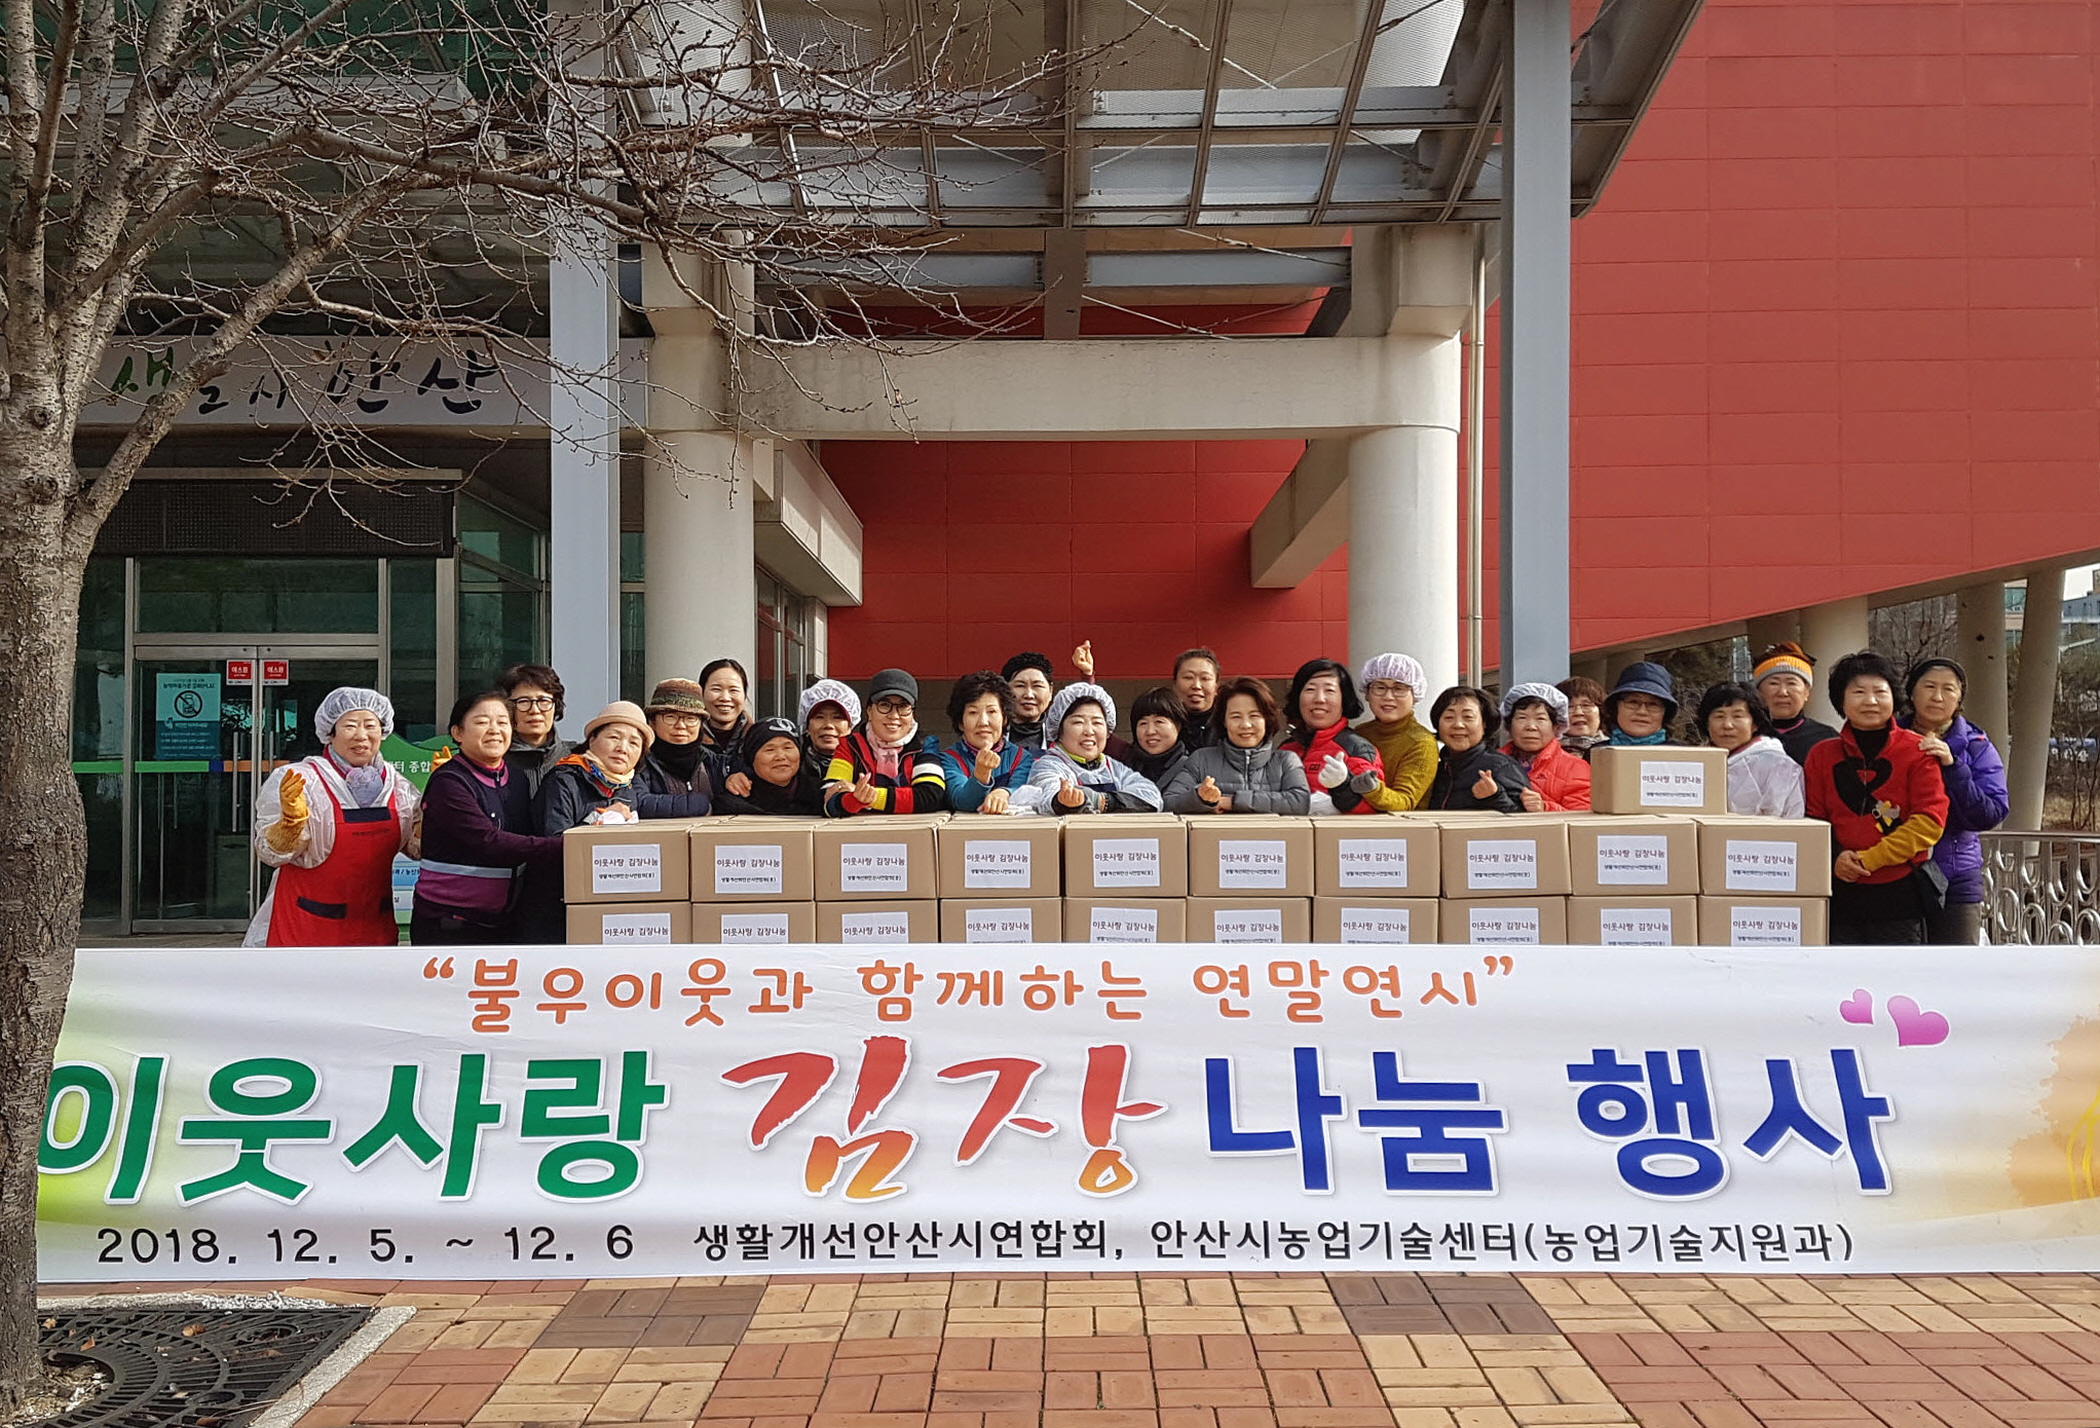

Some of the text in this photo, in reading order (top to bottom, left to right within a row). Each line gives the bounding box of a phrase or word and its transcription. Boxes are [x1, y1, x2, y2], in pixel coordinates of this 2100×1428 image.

[409, 760, 431, 773] 종합
[1642, 774, 1701, 784] 이웃사랑 김장나눔
[966, 852, 1028, 863] 이웃사랑 김장나눔
[1094, 851, 1157, 862] 이웃사랑 김장나눔
[1220, 852, 1283, 863] 이웃사랑 김장나눔
[1340, 852, 1404, 862] 이웃사랑 김장나눔
[1469, 852, 1534, 863] 이웃사랑 김장나눔
[1599, 848, 1665, 859] 이웃사랑 김장나눔
[1727, 853, 1795, 865] 이웃사랑 김장나눔
[593, 857, 658, 868] 이웃사랑 김장나눔
[716, 857, 780, 868] 이웃사랑 김장나눔
[842, 856, 905, 866] 이웃사랑 김장나눔
[843, 924, 906, 936] 이웃사랑 김장나눔
[967, 920, 1030, 932] 이웃사랑 김장나눔
[1092, 920, 1155, 932] 이웃사랑 김장나눔
[1216, 922, 1280, 933] 이웃사랑 김장나눔
[1342, 920, 1407, 932] 이웃사랑 김장나눔
[1471, 920, 1536, 931] 이웃사랑 김장나눔
[1602, 921, 1669, 932] 이웃사랑 김장나눔
[1732, 919, 1798, 931] 이웃사랑 김장나눔
[604, 925, 669, 937] 이웃사랑 김장나눔
[722, 926, 787, 937] 이웃사랑 김장나눔
[857, 959, 1147, 1022] 함께하는
[38, 1034, 1894, 1203] 이웃사랑 김장 나눔 행사
[97, 1227, 237, 1264] 2018.
[266, 1228, 338, 1264] 12.
[369, 1228, 414, 1264] 5.
[503, 1225, 574, 1262] 12.
[606, 1224, 634, 1260] 6
[693, 1219, 1123, 1263] 생활개선안산시연합회,
[1150, 1219, 1854, 1263] 안산시농업기술센터(농업기술지원과)
